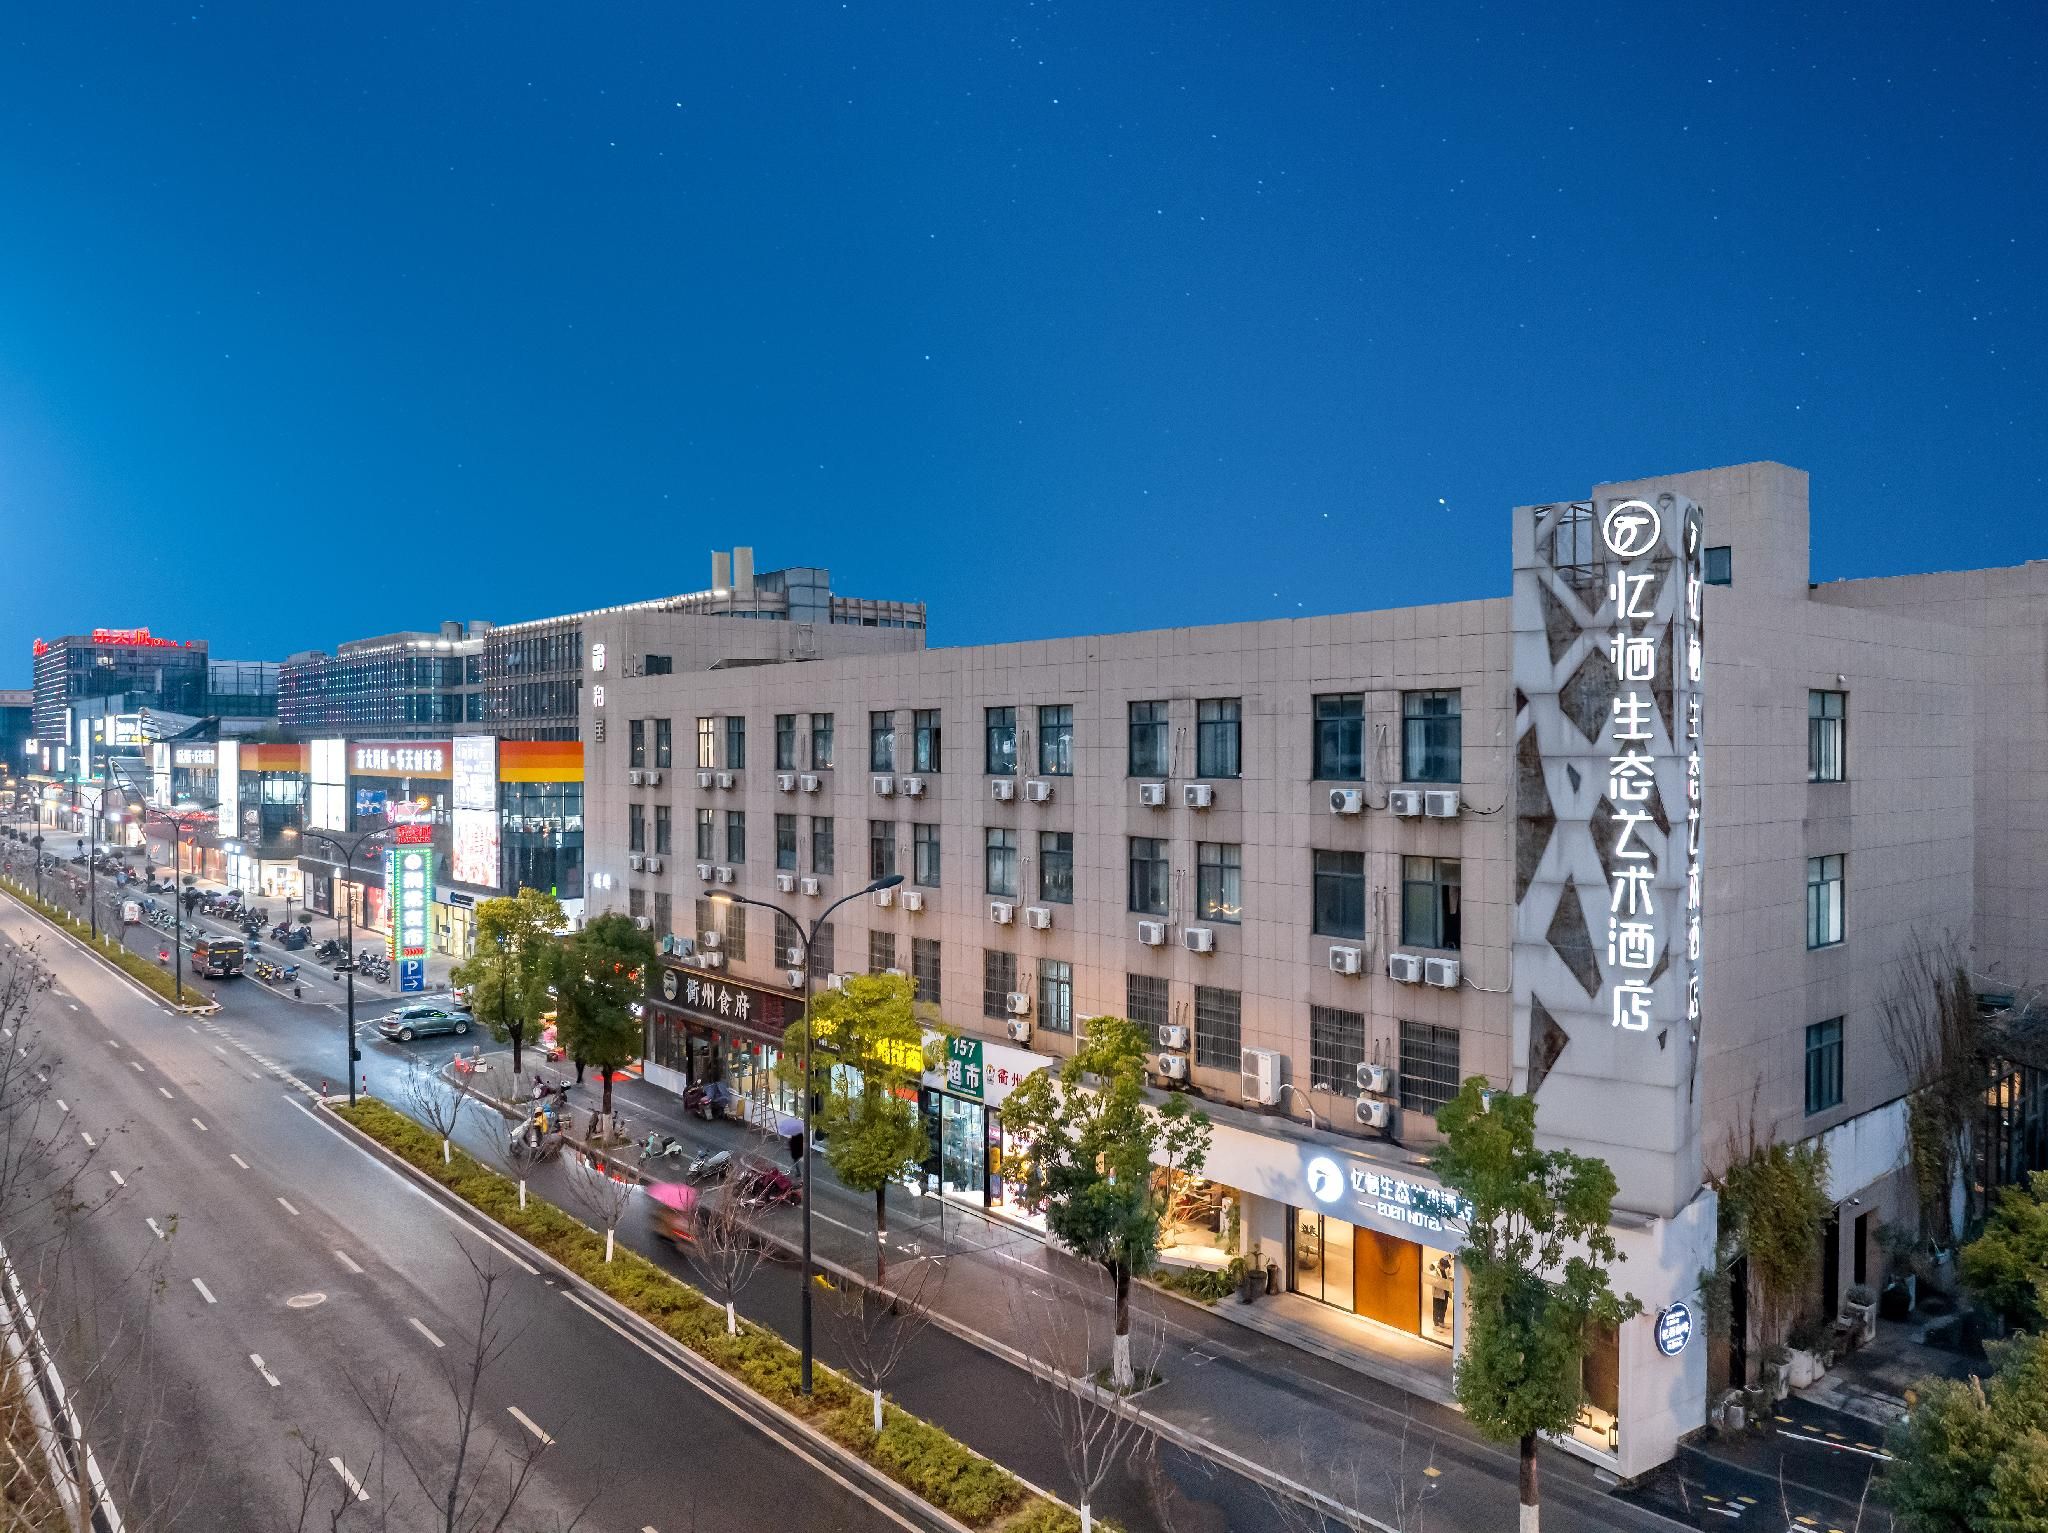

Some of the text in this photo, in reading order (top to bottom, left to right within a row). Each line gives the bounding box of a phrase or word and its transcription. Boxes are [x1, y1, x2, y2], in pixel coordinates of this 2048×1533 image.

[1609, 570, 1656, 1032] 忆栖生态艺术酒店
[408, 960, 419, 975] P
[685, 977, 751, 1020] 衢州食府
[953, 1038, 976, 1058] 157
[946, 1059, 980, 1089] 超市
